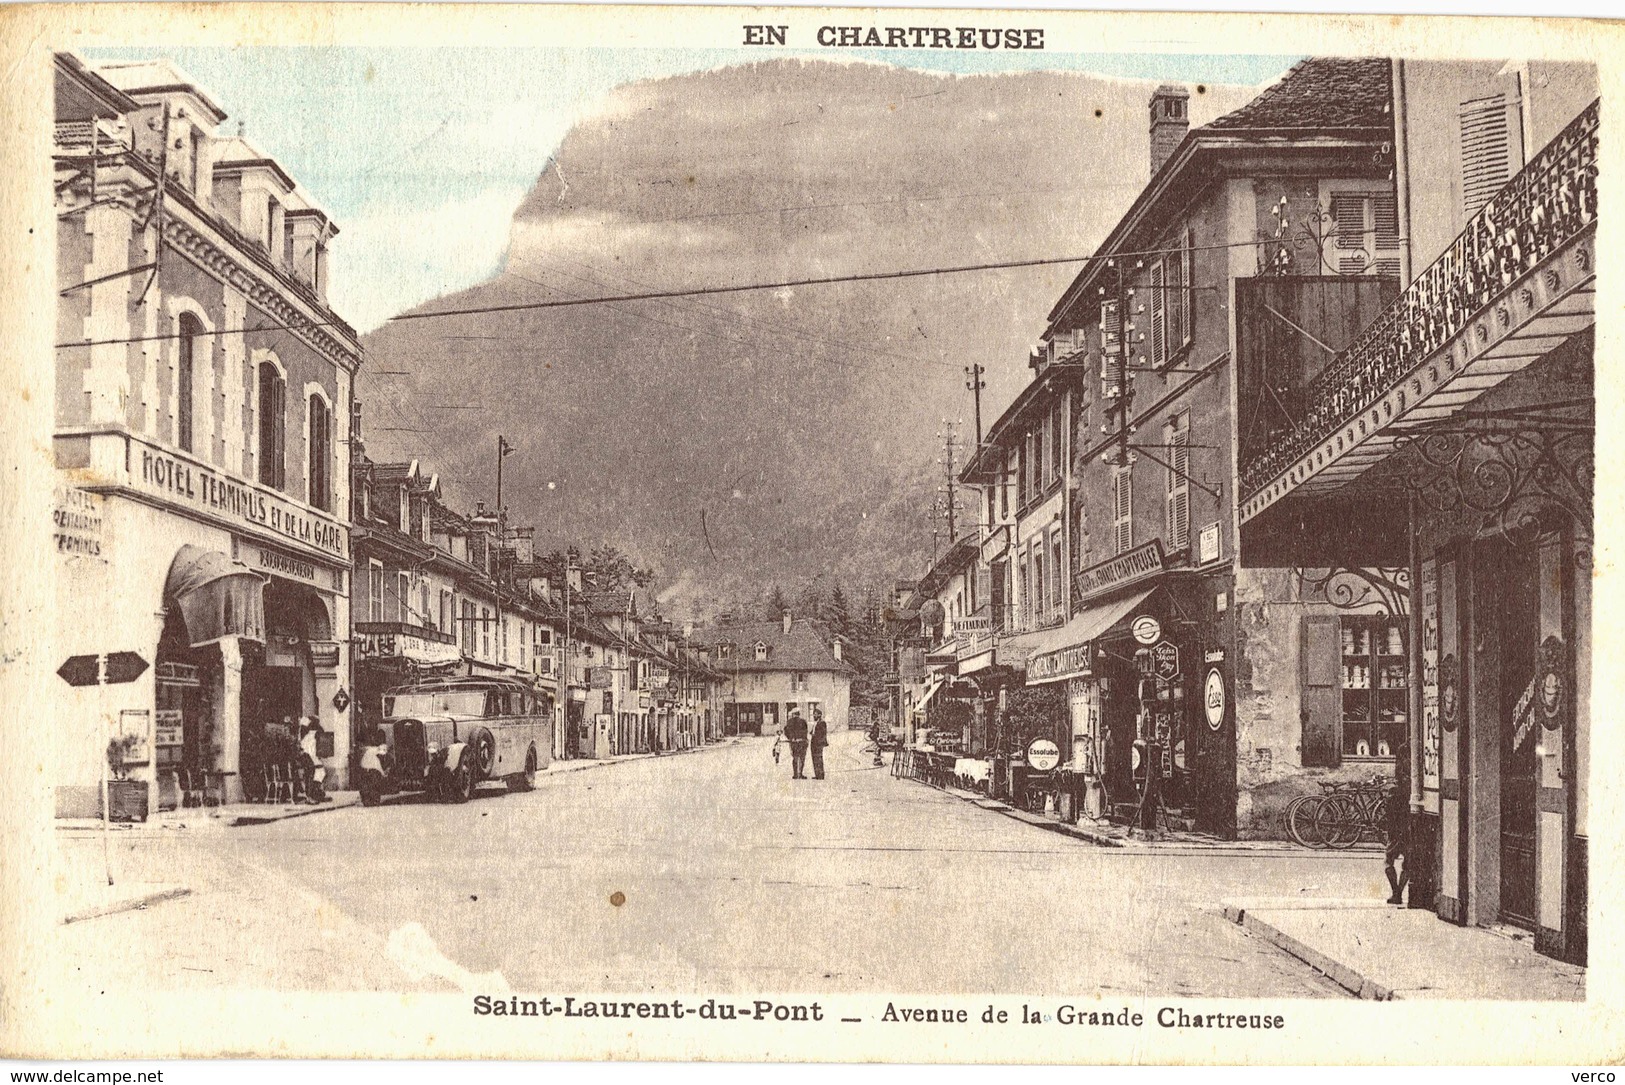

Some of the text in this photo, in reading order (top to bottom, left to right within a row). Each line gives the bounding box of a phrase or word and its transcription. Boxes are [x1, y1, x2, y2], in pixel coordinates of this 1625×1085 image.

[142, 450, 342, 554] HOTEL TERMINUS ET DE LA GARE
[1029, 747, 1059, 756] Essolube
